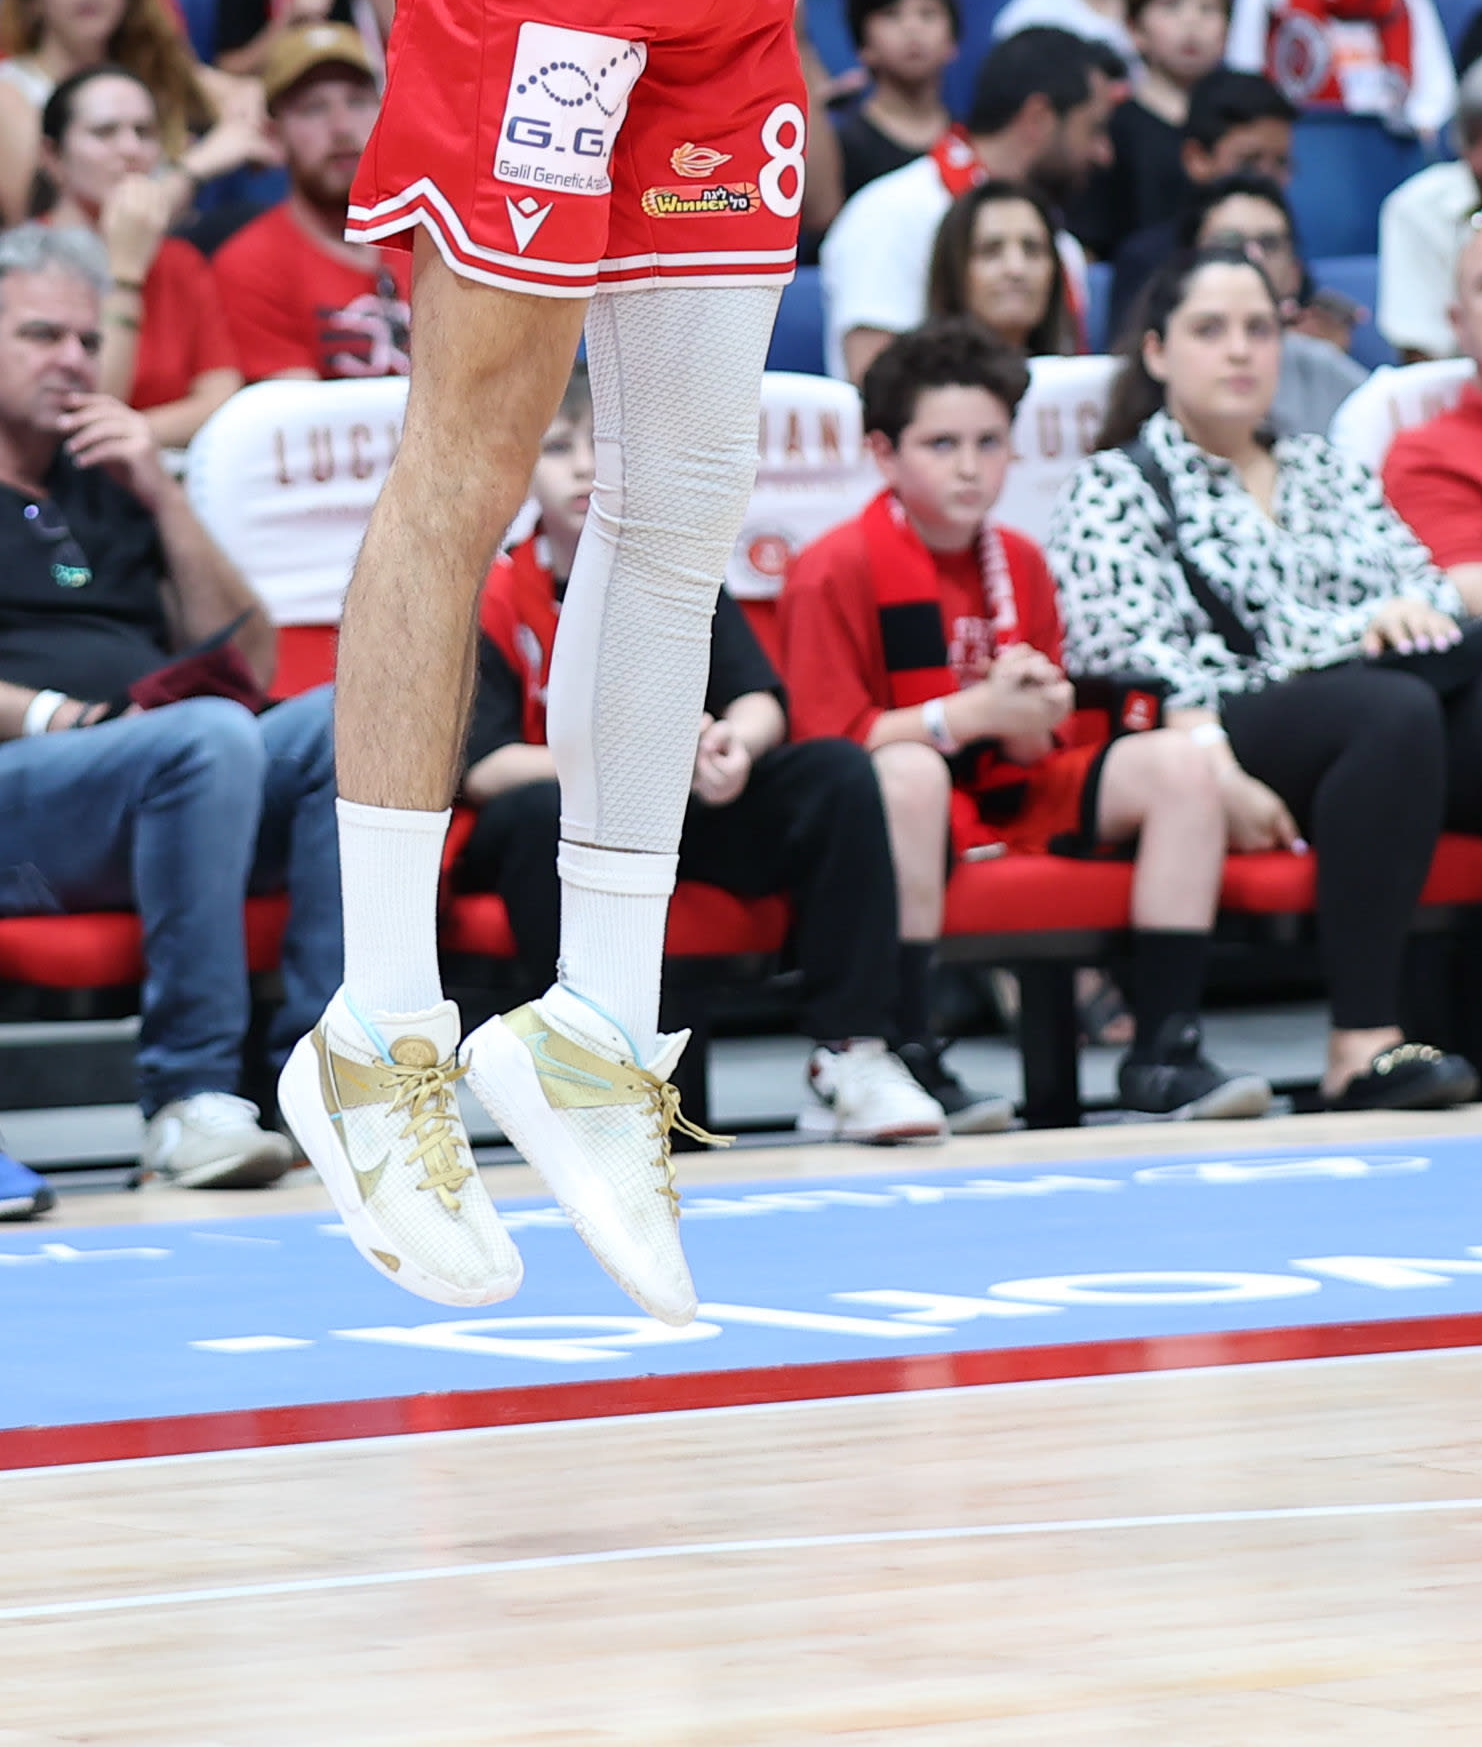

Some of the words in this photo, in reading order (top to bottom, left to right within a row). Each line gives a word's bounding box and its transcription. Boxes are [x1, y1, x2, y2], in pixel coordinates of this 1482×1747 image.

[498, 159, 532, 180] Galil
[533, 166, 586, 191] Genetic
[757, 102, 807, 218] 8
[655, 194, 729, 214] Winner
